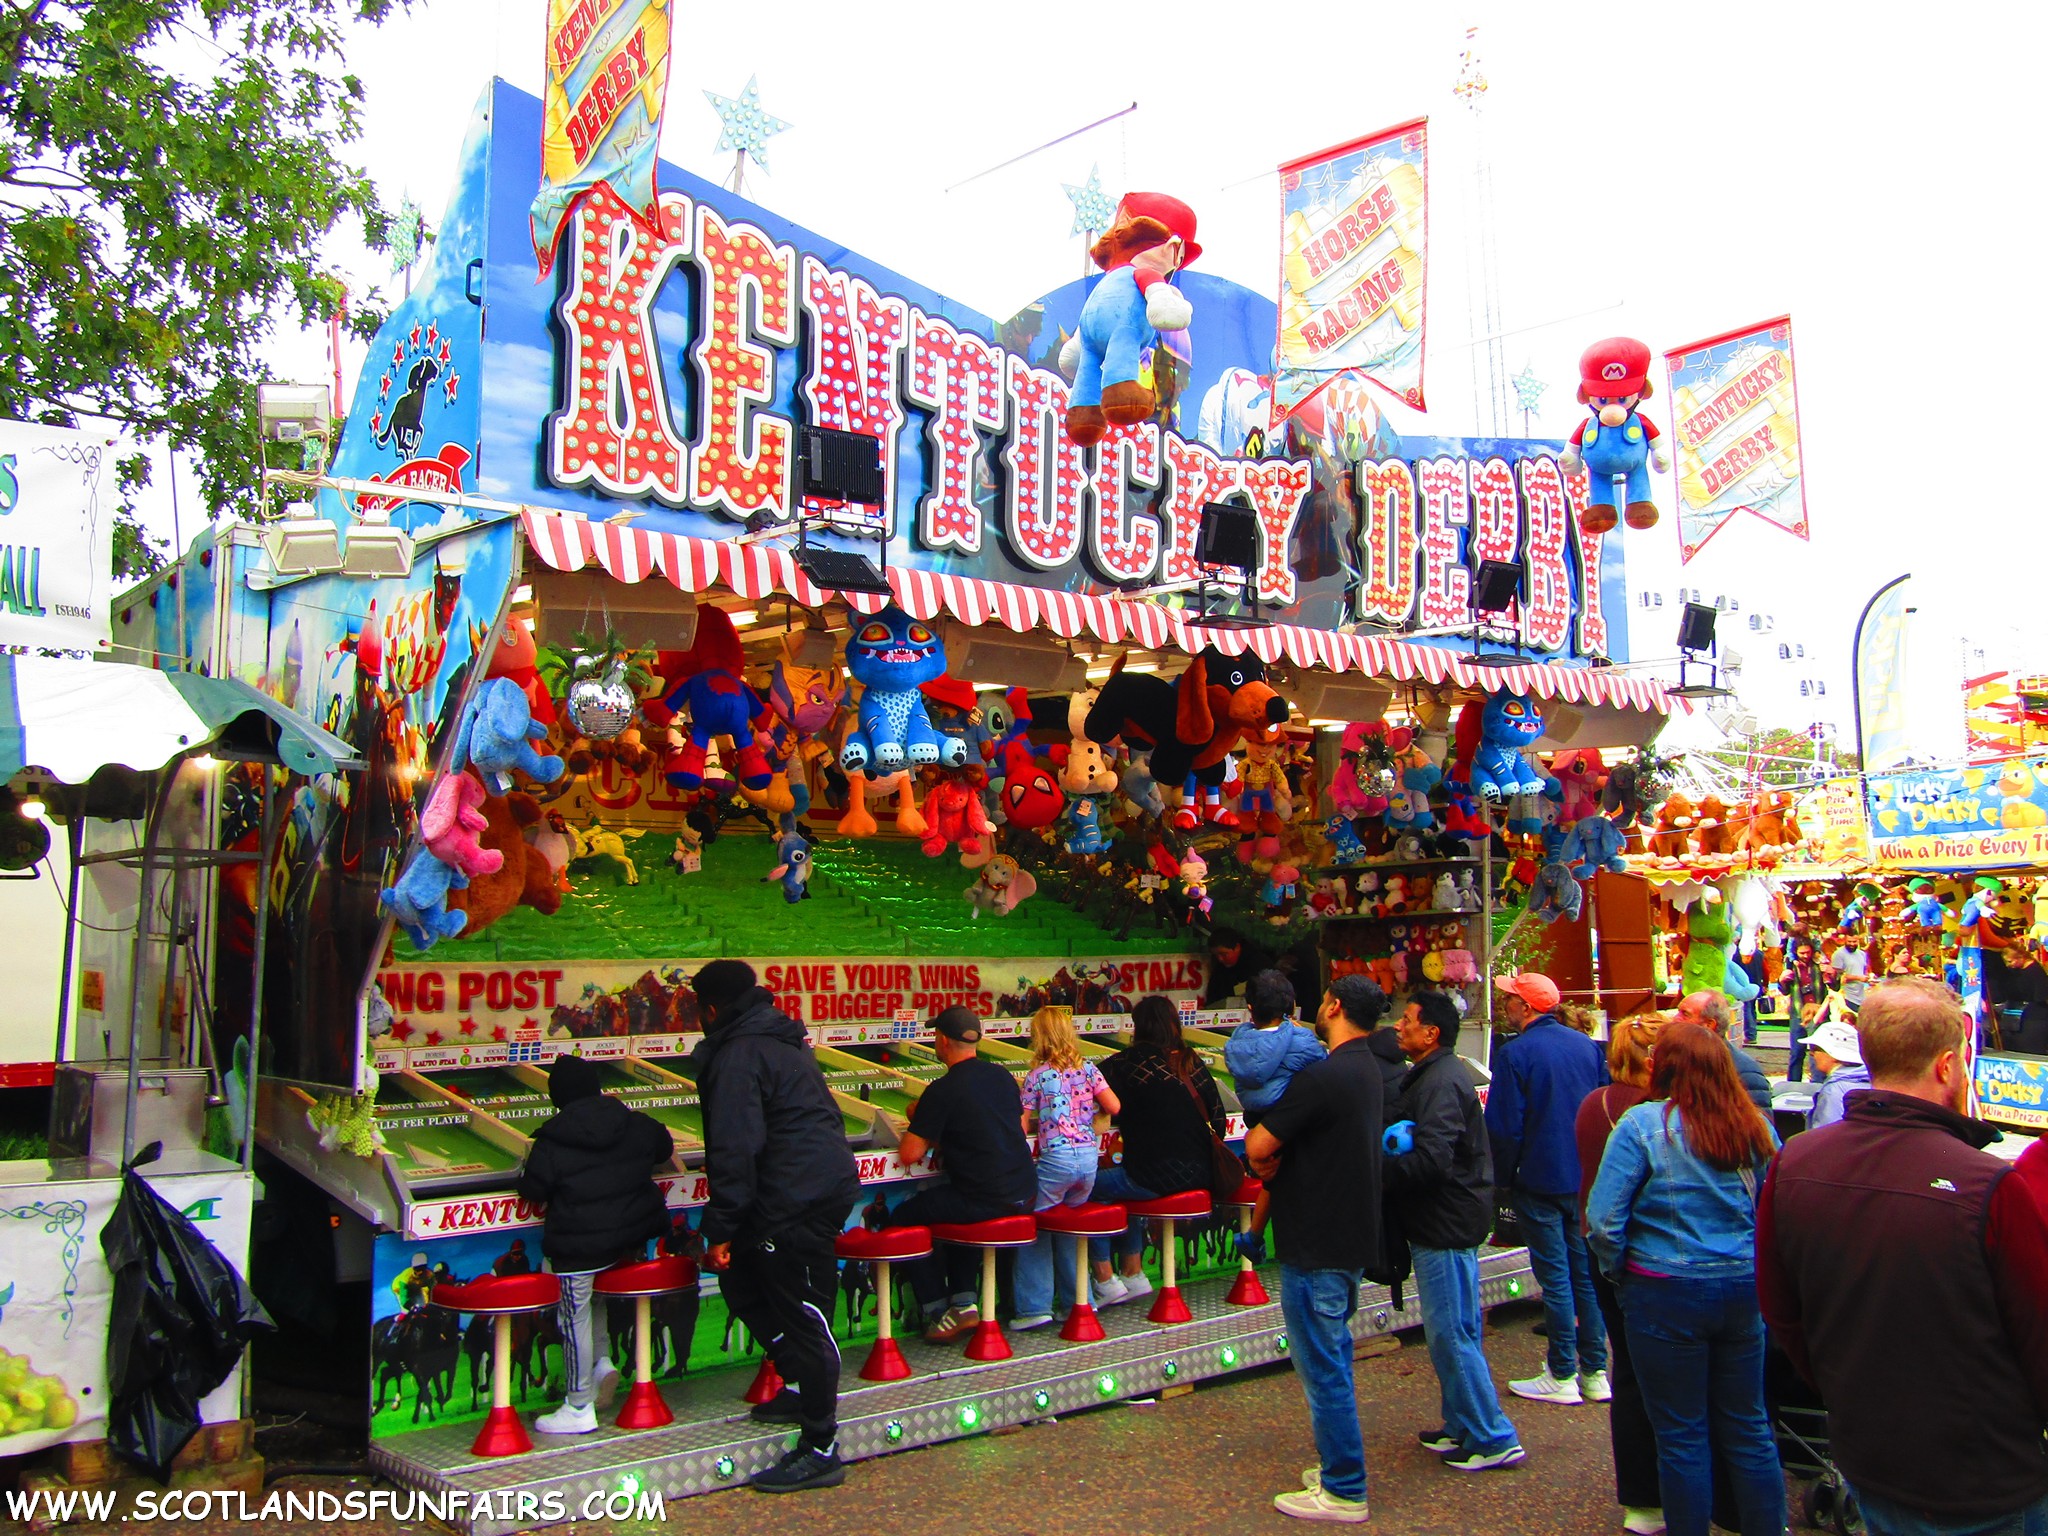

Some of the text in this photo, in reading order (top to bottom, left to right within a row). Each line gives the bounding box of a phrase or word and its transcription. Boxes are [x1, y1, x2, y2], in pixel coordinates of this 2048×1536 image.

[565, 25, 649, 165] DERBY
[1301, 183, 1398, 279] HORSE
[1300, 257, 1404, 355] RACING
[1605, 366, 1622, 378] M
[1681, 353, 1786, 444] KENTUCKY
[552, 188, 1608, 657] KENTUCKY DERBY
[1700, 425, 1778, 495] DERBY
[410, 469, 447, 492] RACER
[1879, 834, 2048, 859] Win a Prize Every Ti
[458, 970, 563, 1011] POST
[765, 964, 981, 992] SAVE YOUR WINS
[1120, 961, 1203, 993] STALLS
[811, 993, 903, 1021] BIGGER
[911, 991, 993, 1017] PRIZES
[875, 1080, 904, 1089] PLAYER
[381, 1102, 413, 1111] MONEY
[476, 1096, 507, 1105] PLACE
[509, 1094, 539, 1103] MONEY
[498, 1108, 530, 1119] BALLS
[533, 1106, 553, 1116] PER
[624, 1096, 700, 1109] ALLS PER PLAYE
[372, 1115, 469, 1129] ALLS PER PLAYER
[1983, 1105, 2002, 1117] Win
[2013, 1109, 2042, 1123] Prize
[439, 1196, 547, 1231] KENTUC
